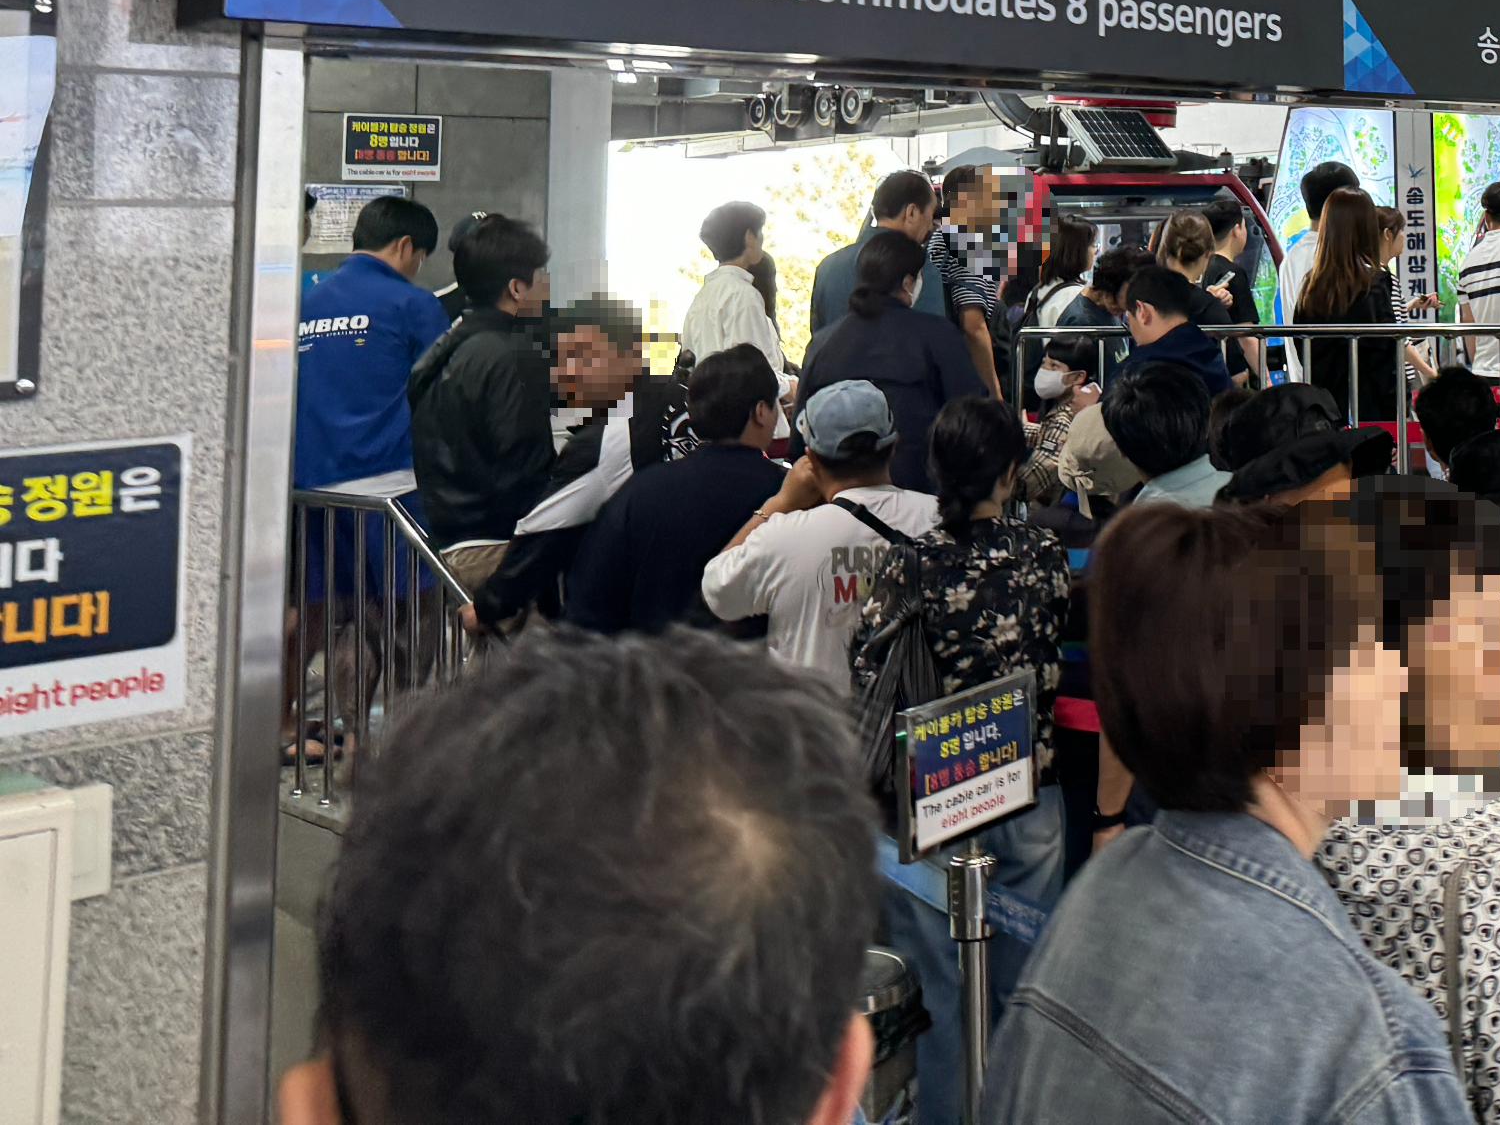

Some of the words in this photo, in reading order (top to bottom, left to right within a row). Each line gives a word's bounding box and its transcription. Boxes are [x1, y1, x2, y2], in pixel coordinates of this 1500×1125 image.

[370, 134, 388, 148] 8명
[389, 135, 419, 148] 입니다
[21, 466, 161, 522] 정원은
[0, 537, 64, 589] 다
[0, 590, 110, 644] 니다]
[69, 666, 165, 707] people
[914, 710, 962, 742] 케이블카
[964, 702, 988, 725] 탑승
[991, 688, 1024, 714] 정원은
[940, 736, 961, 759] 8명
[962, 722, 1001, 751] 입니다
[922, 801, 942, 819] The
[976, 782, 993, 796] car
[995, 775, 1005, 789] is
